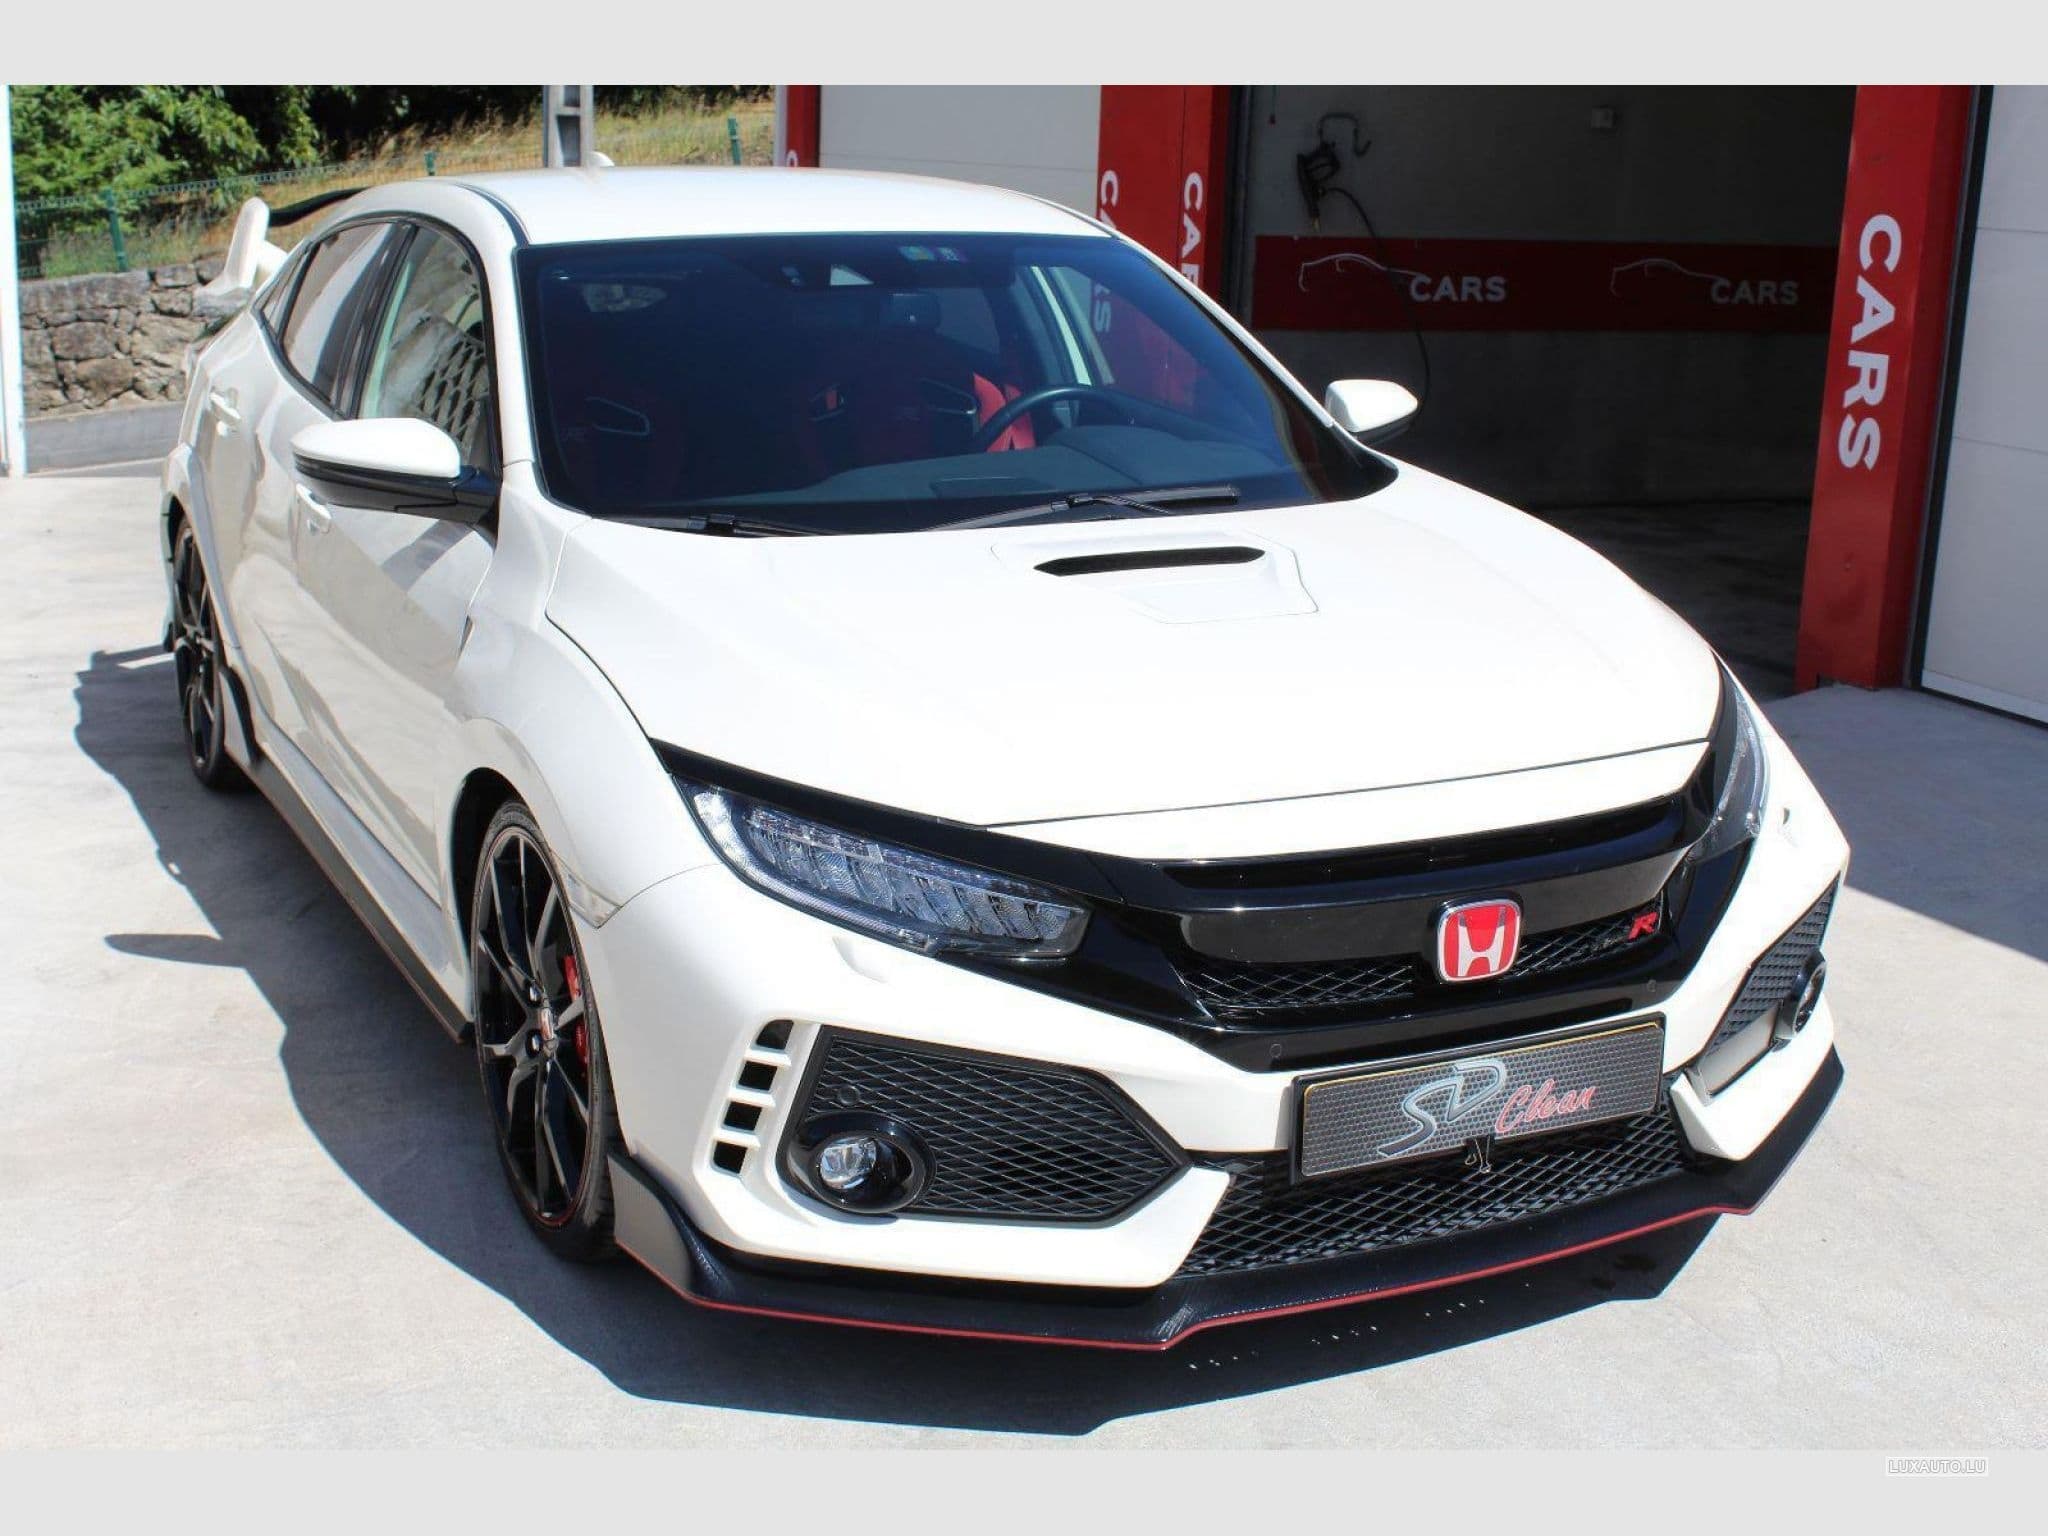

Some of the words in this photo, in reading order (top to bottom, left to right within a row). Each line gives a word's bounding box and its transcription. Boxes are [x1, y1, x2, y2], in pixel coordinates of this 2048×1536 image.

[1409, 275, 1507, 302] CARS
[1711, 277, 1799, 304] CARS
[1837, 213, 1901, 471] CARS
[1495, 1078, 1596, 1133] Clean
